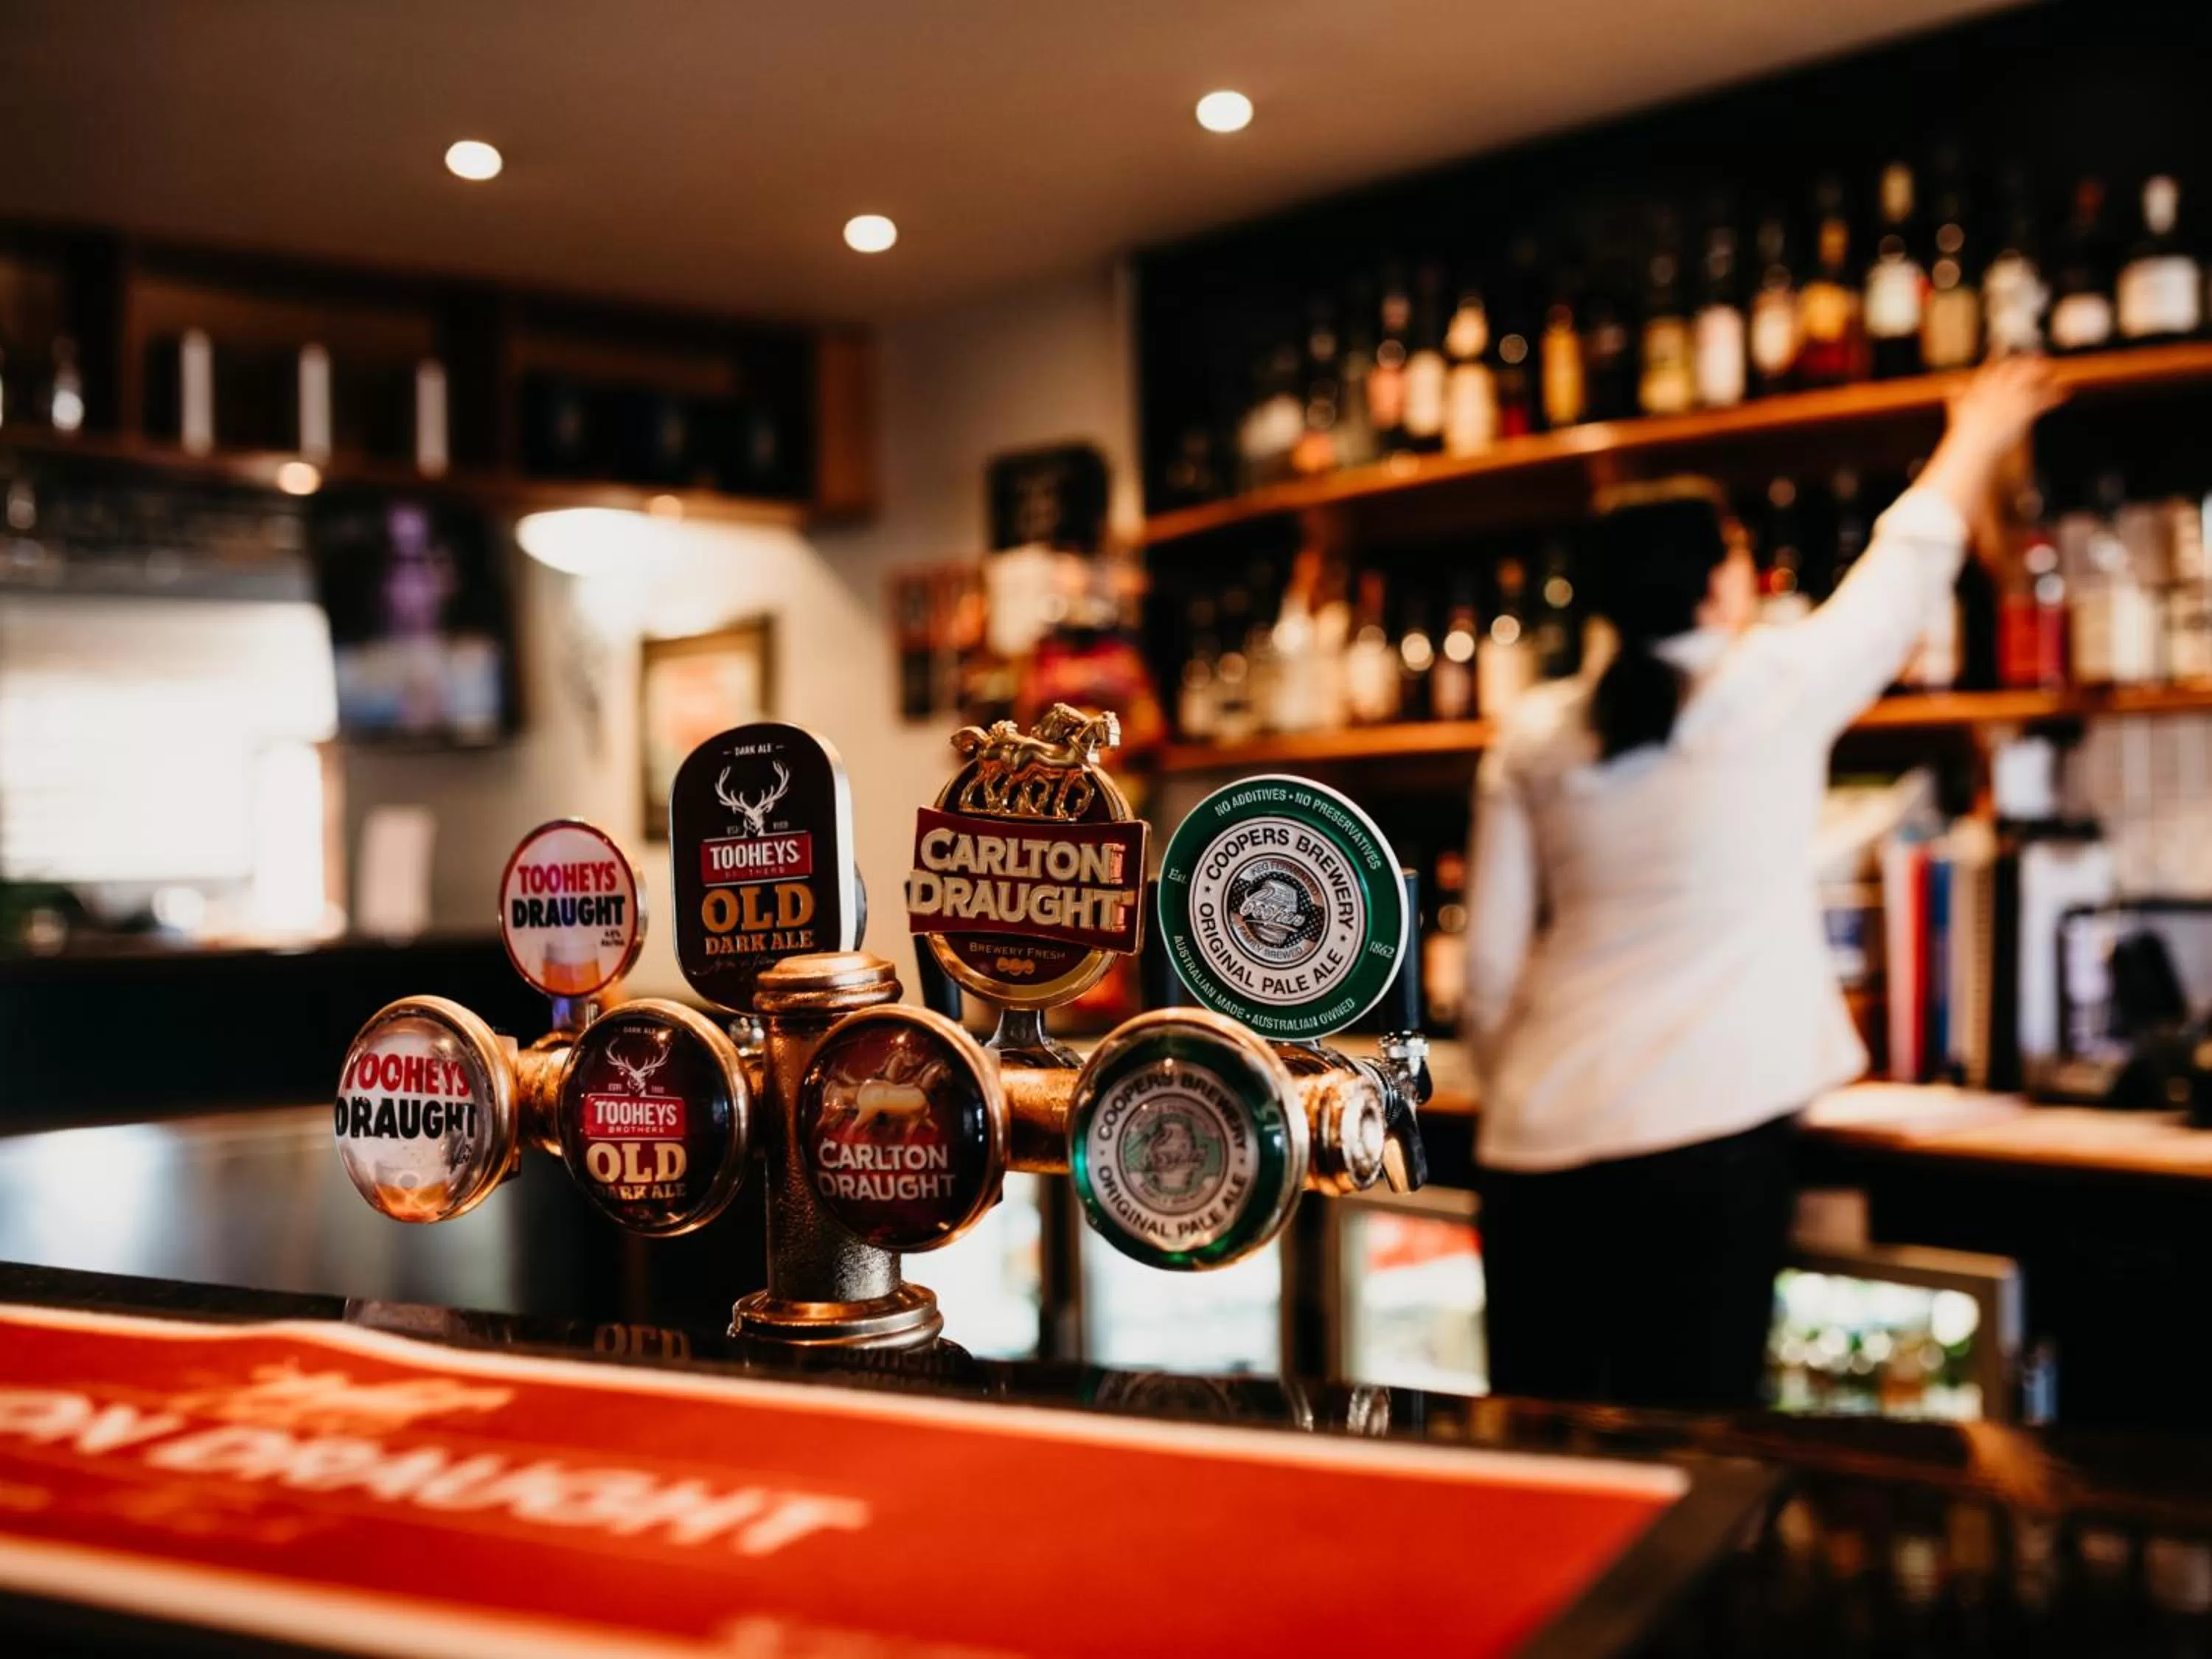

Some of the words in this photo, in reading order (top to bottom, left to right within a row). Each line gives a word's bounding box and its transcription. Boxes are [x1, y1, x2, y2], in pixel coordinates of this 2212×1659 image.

[1215, 801, 1231, 816] NO
[1232, 788, 1287, 809] ADDITIVES
[1295, 792, 1312, 807] NO
[1312, 800, 1381, 871] PRESERVATIVES
[709, 839, 801, 871] TOOHEYS
[920, 827, 1125, 884] CARLTON
[518, 861, 616, 895] TOOHEYS
[1207, 828, 1290, 880] COOPERS
[1296, 834, 1354, 930] BREWERY
[512, 895, 625, 928] DRAUGHT
[701, 883, 814, 933] OLD
[907, 870, 1135, 932] DRAUGHT
[705, 933, 767, 956] DARK
[771, 931, 815, 950] ALE
[969, 942, 1023, 956] BREWERY
[1200, 902, 1254, 988] ORIGINAL
[1262, 977, 1310, 995] PALE
[1315, 949, 1344, 984] ALE
[1369, 940, 1395, 959] 1862
[1173, 935, 1216, 998] AUSTRALIAN
[1215, 994, 1246, 1019] MADE
[1251, 1013, 1318, 1031] AUSTRALIAN
[1319, 997, 1356, 1025] OWNED
[335, 1096, 478, 1140] DRAUGHT
[594, 1101, 678, 1127] TOOHEYS
[1097, 1073, 1174, 1142] COOPERS
[586, 1143, 687, 1183] OLD
[818, 1139, 947, 1170] CARLTON
[817, 1172, 956, 1200] DRAUGHT
[1099, 1166, 1170, 1237] ORIGINAL
[1178, 1209, 1225, 1238] PALE
[1222, 1173, 1246, 1211] ALE
